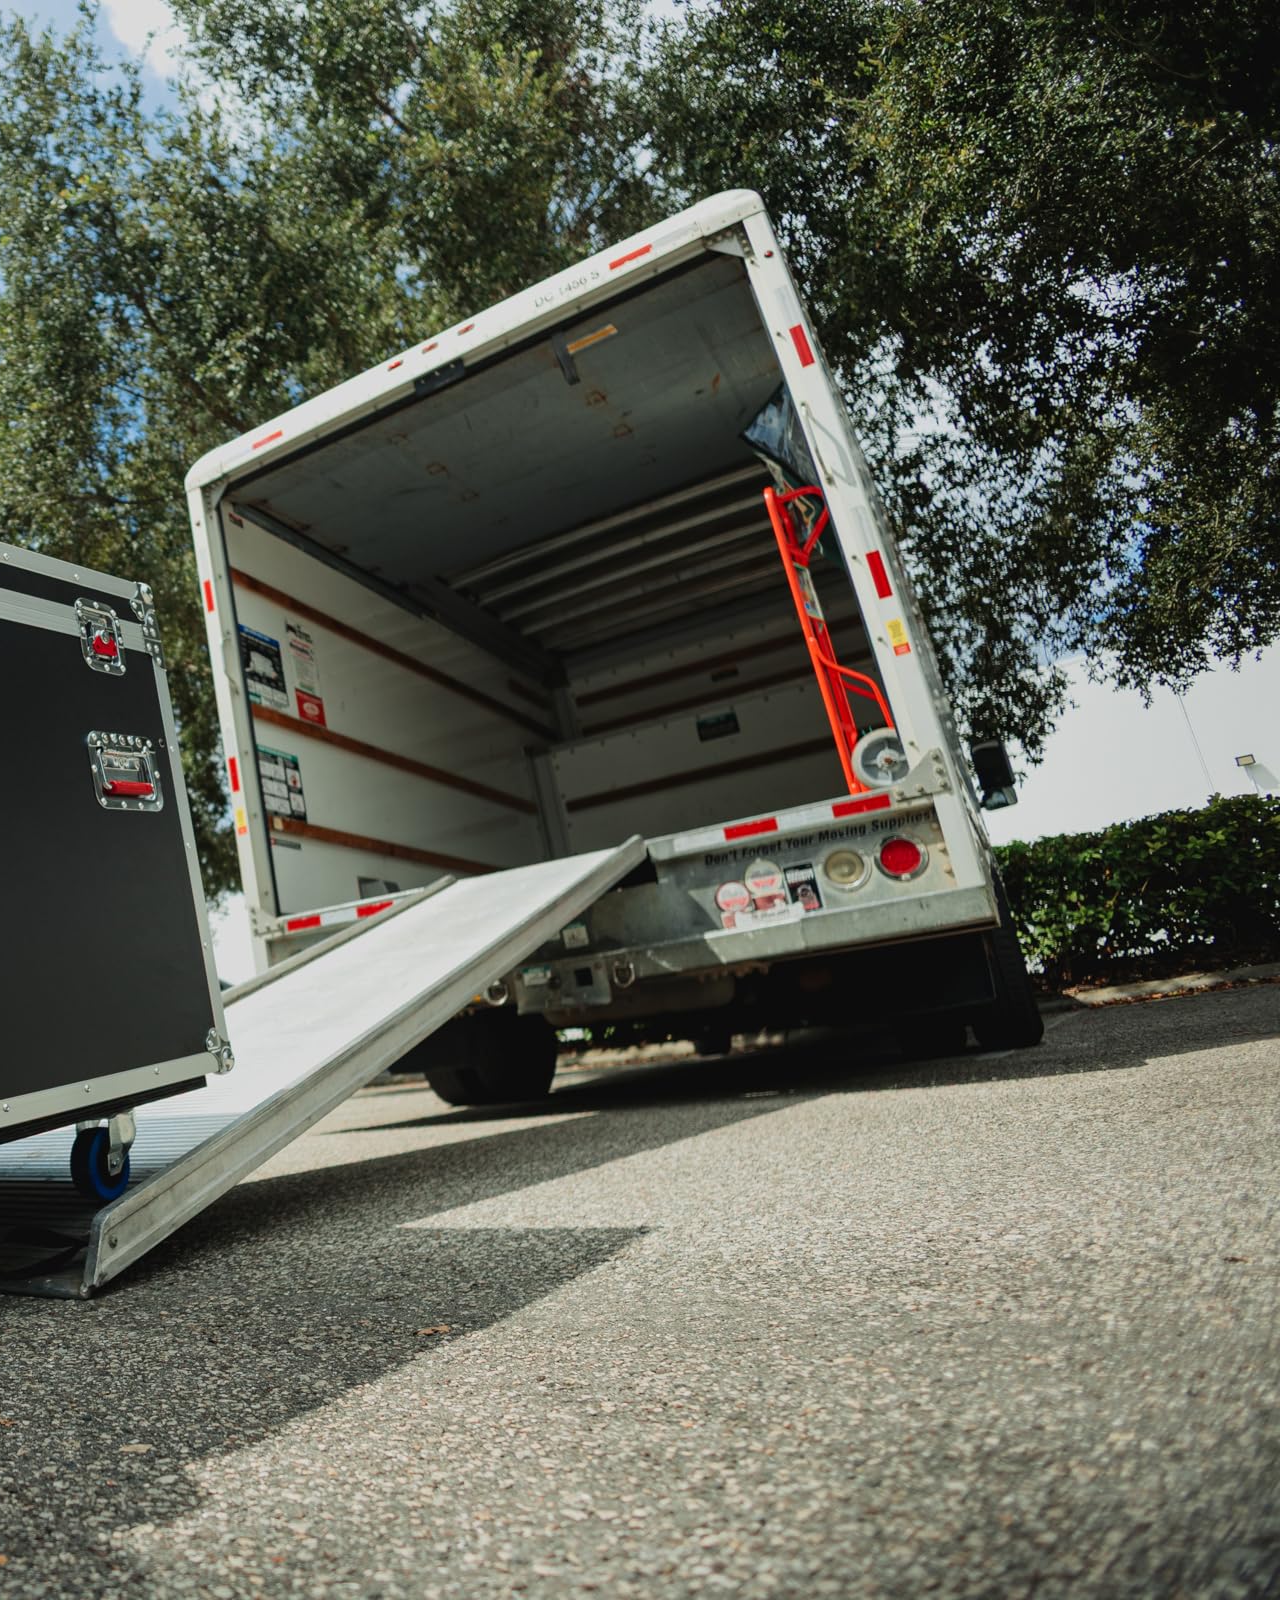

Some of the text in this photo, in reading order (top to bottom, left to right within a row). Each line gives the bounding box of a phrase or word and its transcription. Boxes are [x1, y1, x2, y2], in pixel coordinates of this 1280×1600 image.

[705, 849, 737, 866] Don't
[742, 840, 782, 858] Forget
[786, 836, 814, 850] Your
[819, 824, 866, 840] Moving
